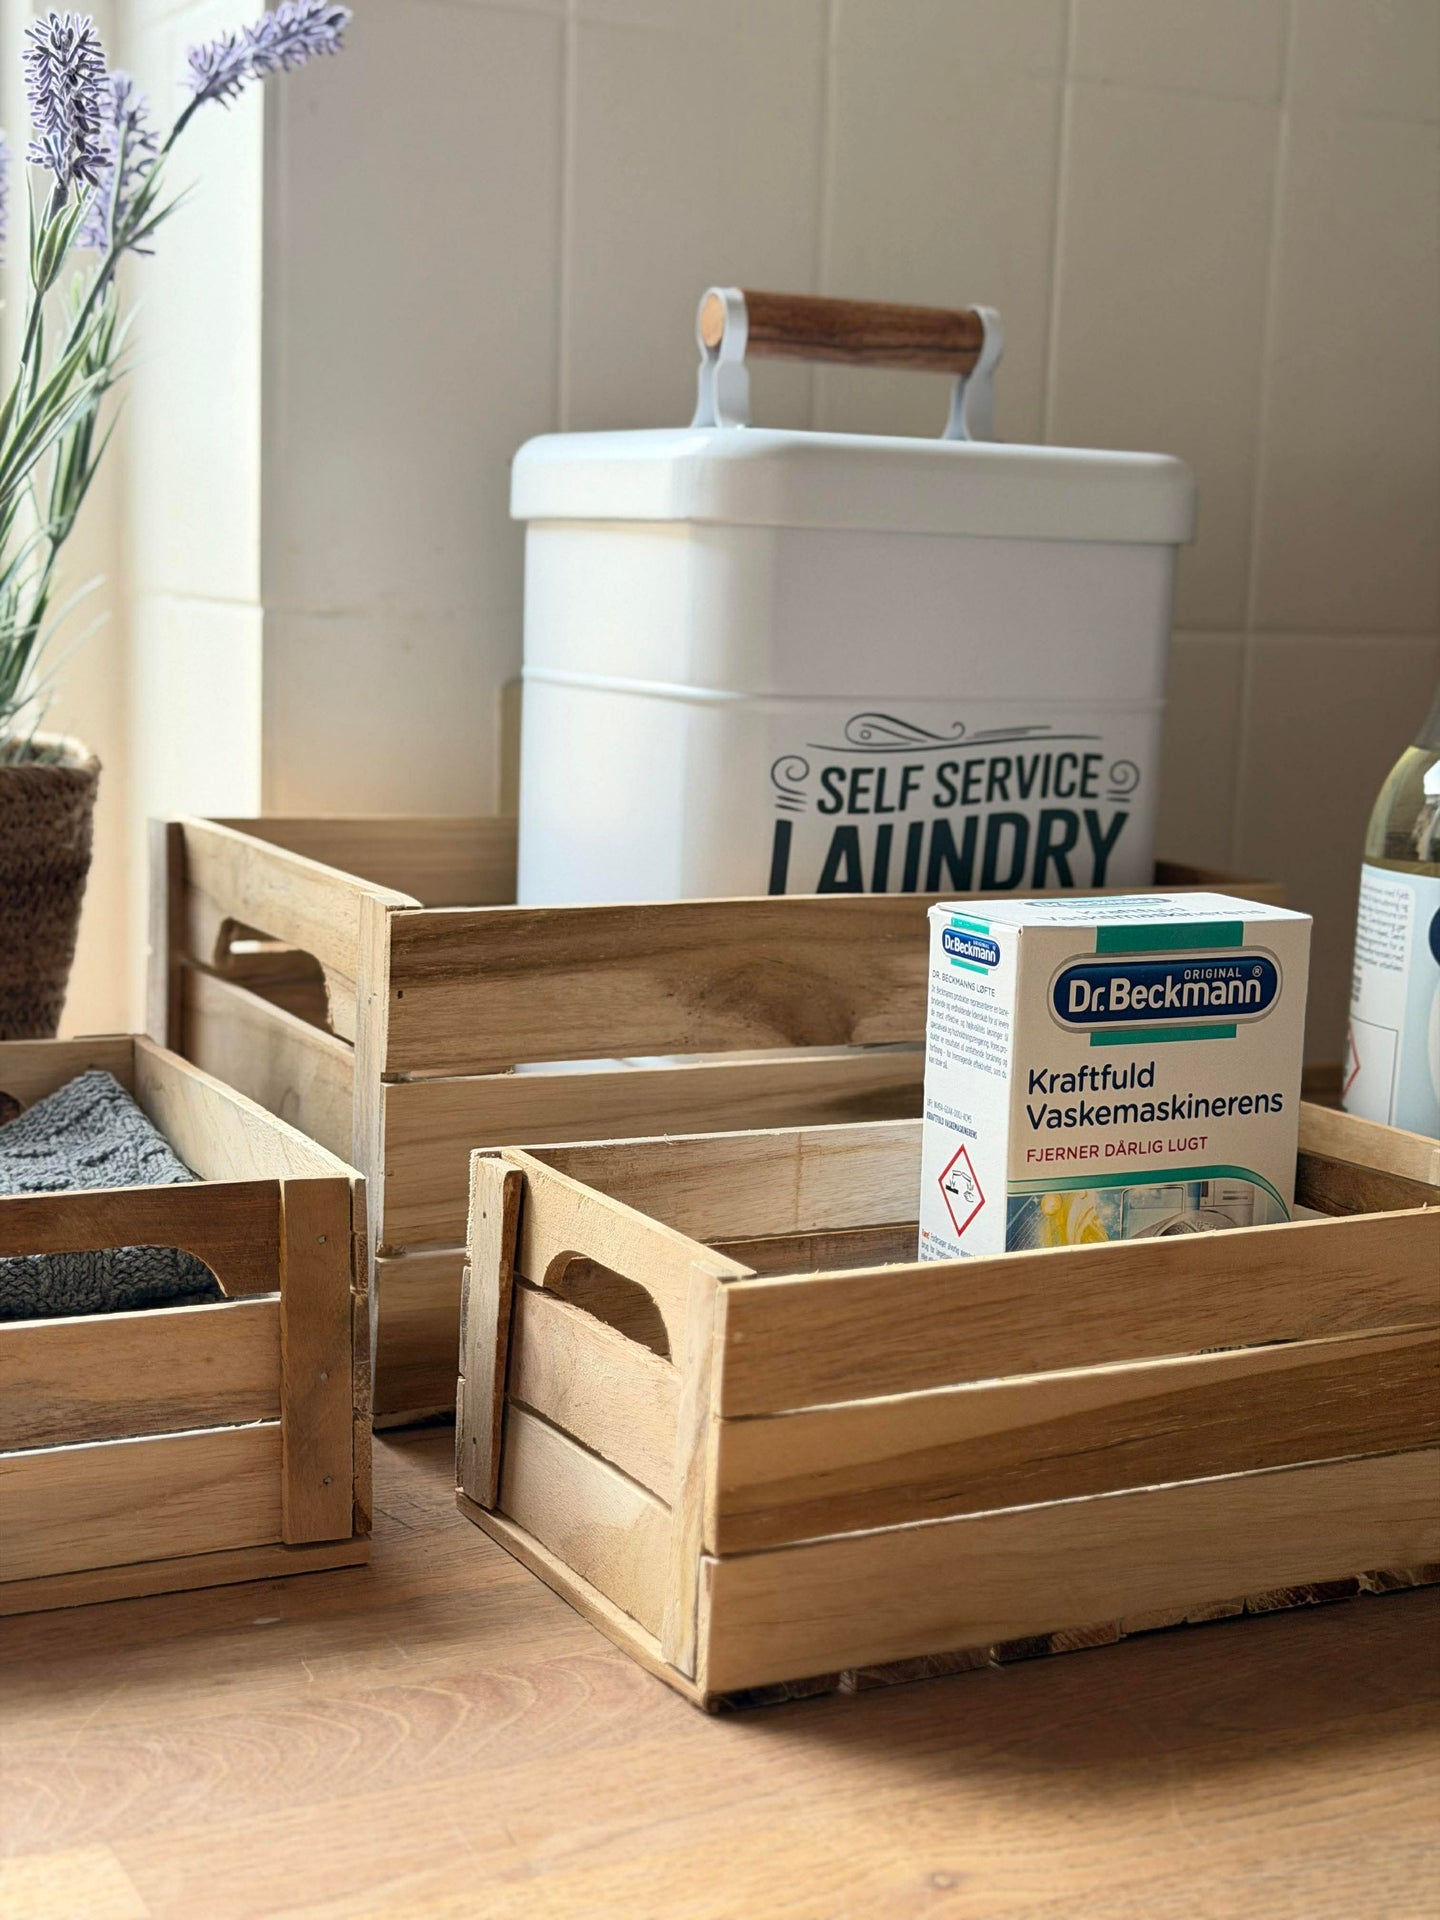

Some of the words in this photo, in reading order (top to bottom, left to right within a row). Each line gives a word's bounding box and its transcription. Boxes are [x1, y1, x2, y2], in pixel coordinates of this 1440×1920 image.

[817, 763, 925, 815] SELF
[932, 752, 1104, 809] SERVICE
[932, 970, 941, 980] DR.
[942, 973, 976, 991] BECKMANNS
[976, 984, 995, 997] LØFTE
[1184, 967, 1242, 980] ORIGINAL
[1028, 1061, 1155, 1095] Kraftfuld
[1026, 1092, 1284, 1130] Vaskemaskinerens
[1027, 1144, 1100, 1163] FJERNER
[1104, 1140, 1164, 1157] DÅRLIG
[1168, 1136, 1209, 1152] LUGT
